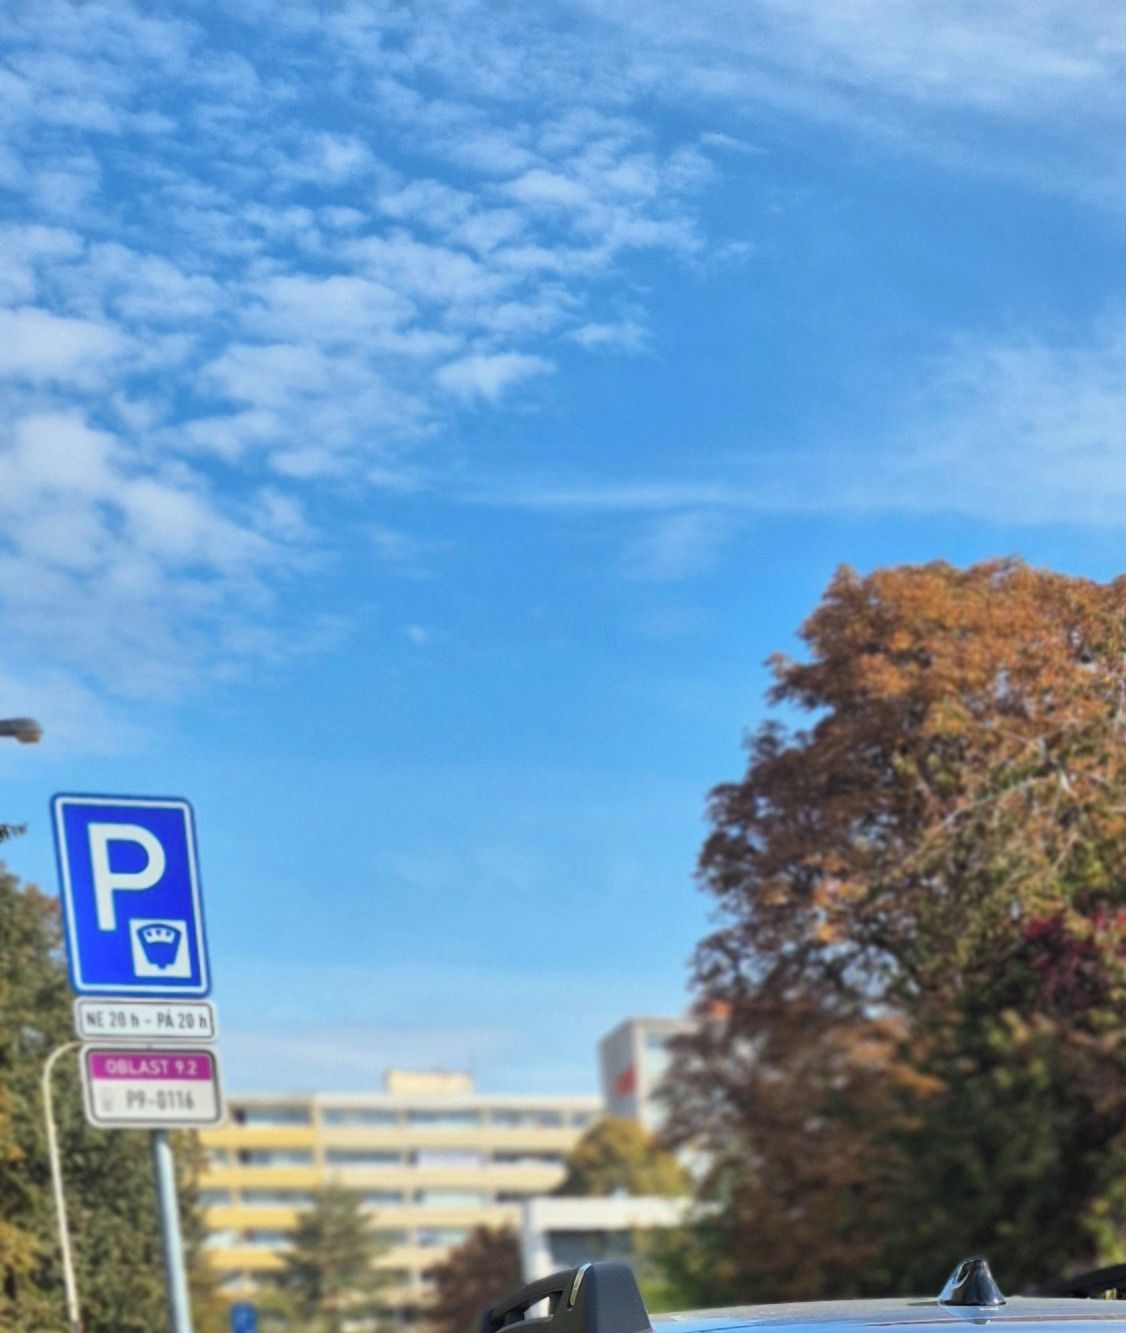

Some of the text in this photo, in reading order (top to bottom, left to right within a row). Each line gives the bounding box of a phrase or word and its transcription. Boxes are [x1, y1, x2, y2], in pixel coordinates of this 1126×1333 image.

[88, 822, 166, 931] P
[86, 1011, 103, 1027] NE
[109, 1012, 126, 1028] 20
[131, 1012, 140, 1028] h
[177, 1013, 195, 1029] 20
[199, 1013, 208, 1029] h
[105, 1059, 169, 1075] OBLAST
